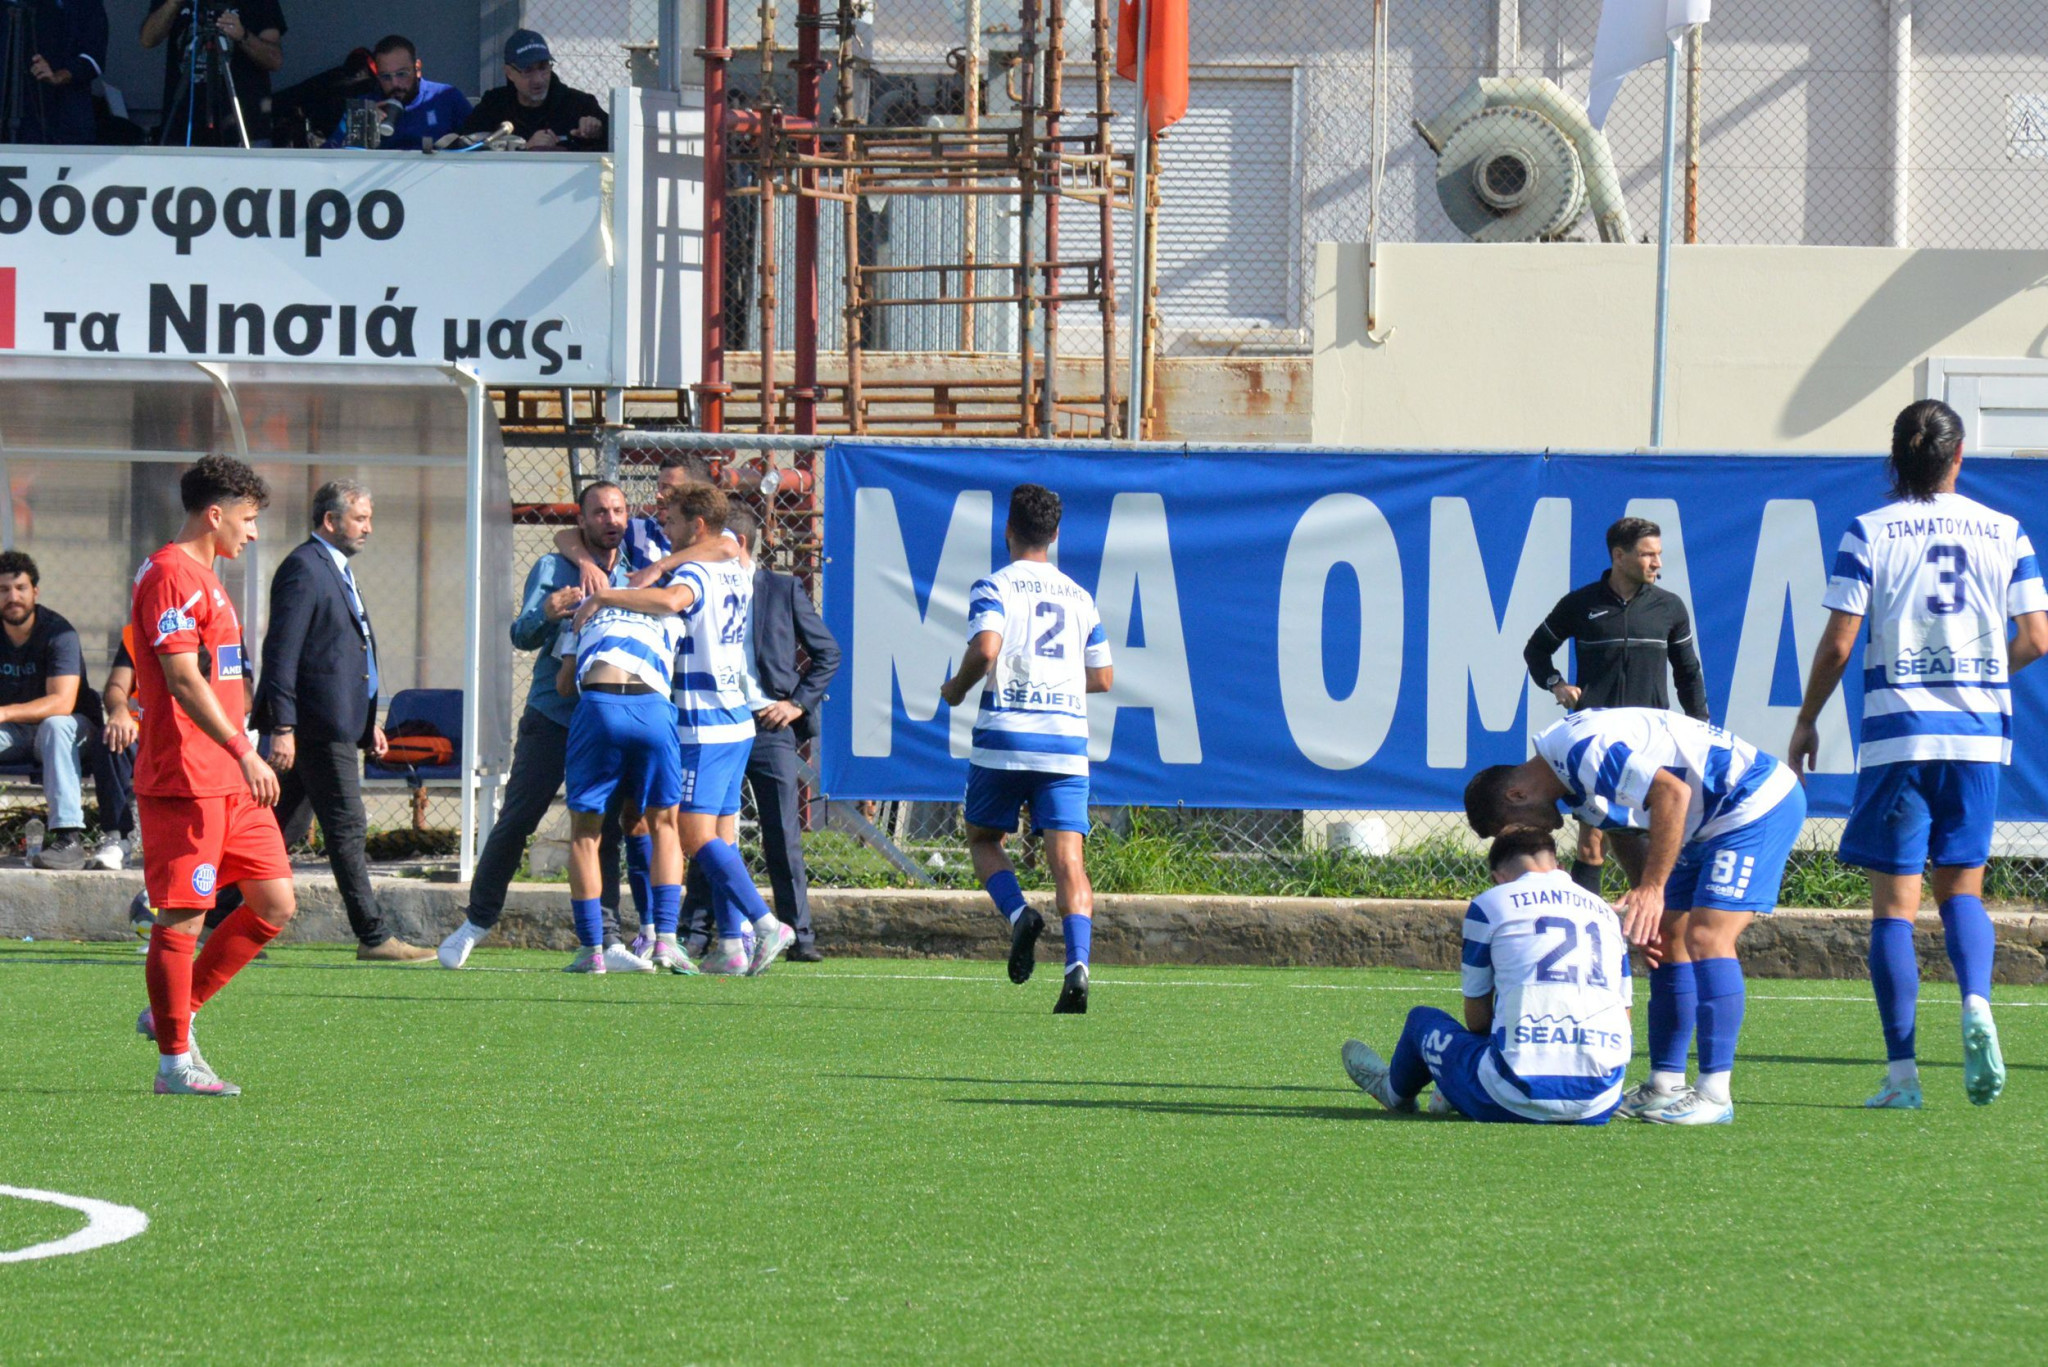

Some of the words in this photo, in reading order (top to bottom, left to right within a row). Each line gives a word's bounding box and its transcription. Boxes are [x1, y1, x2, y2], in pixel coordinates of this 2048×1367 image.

[44, 311, 120, 352] τα
[148, 283, 418, 357] Νησιά
[443, 318, 583, 376] μας.
[1925, 544, 1967, 615] 3
[851, 486, 1203, 765] ΜΑ
[1034, 601, 1065, 659] 2
[1894, 657, 2000, 676] SEAJETS
[1003, 688, 1082, 710] SEAJETS
[1711, 849, 1738, 884] 8
[1534, 916, 1608, 987] 21
[1514, 1025, 1622, 1051] SEAJETS
